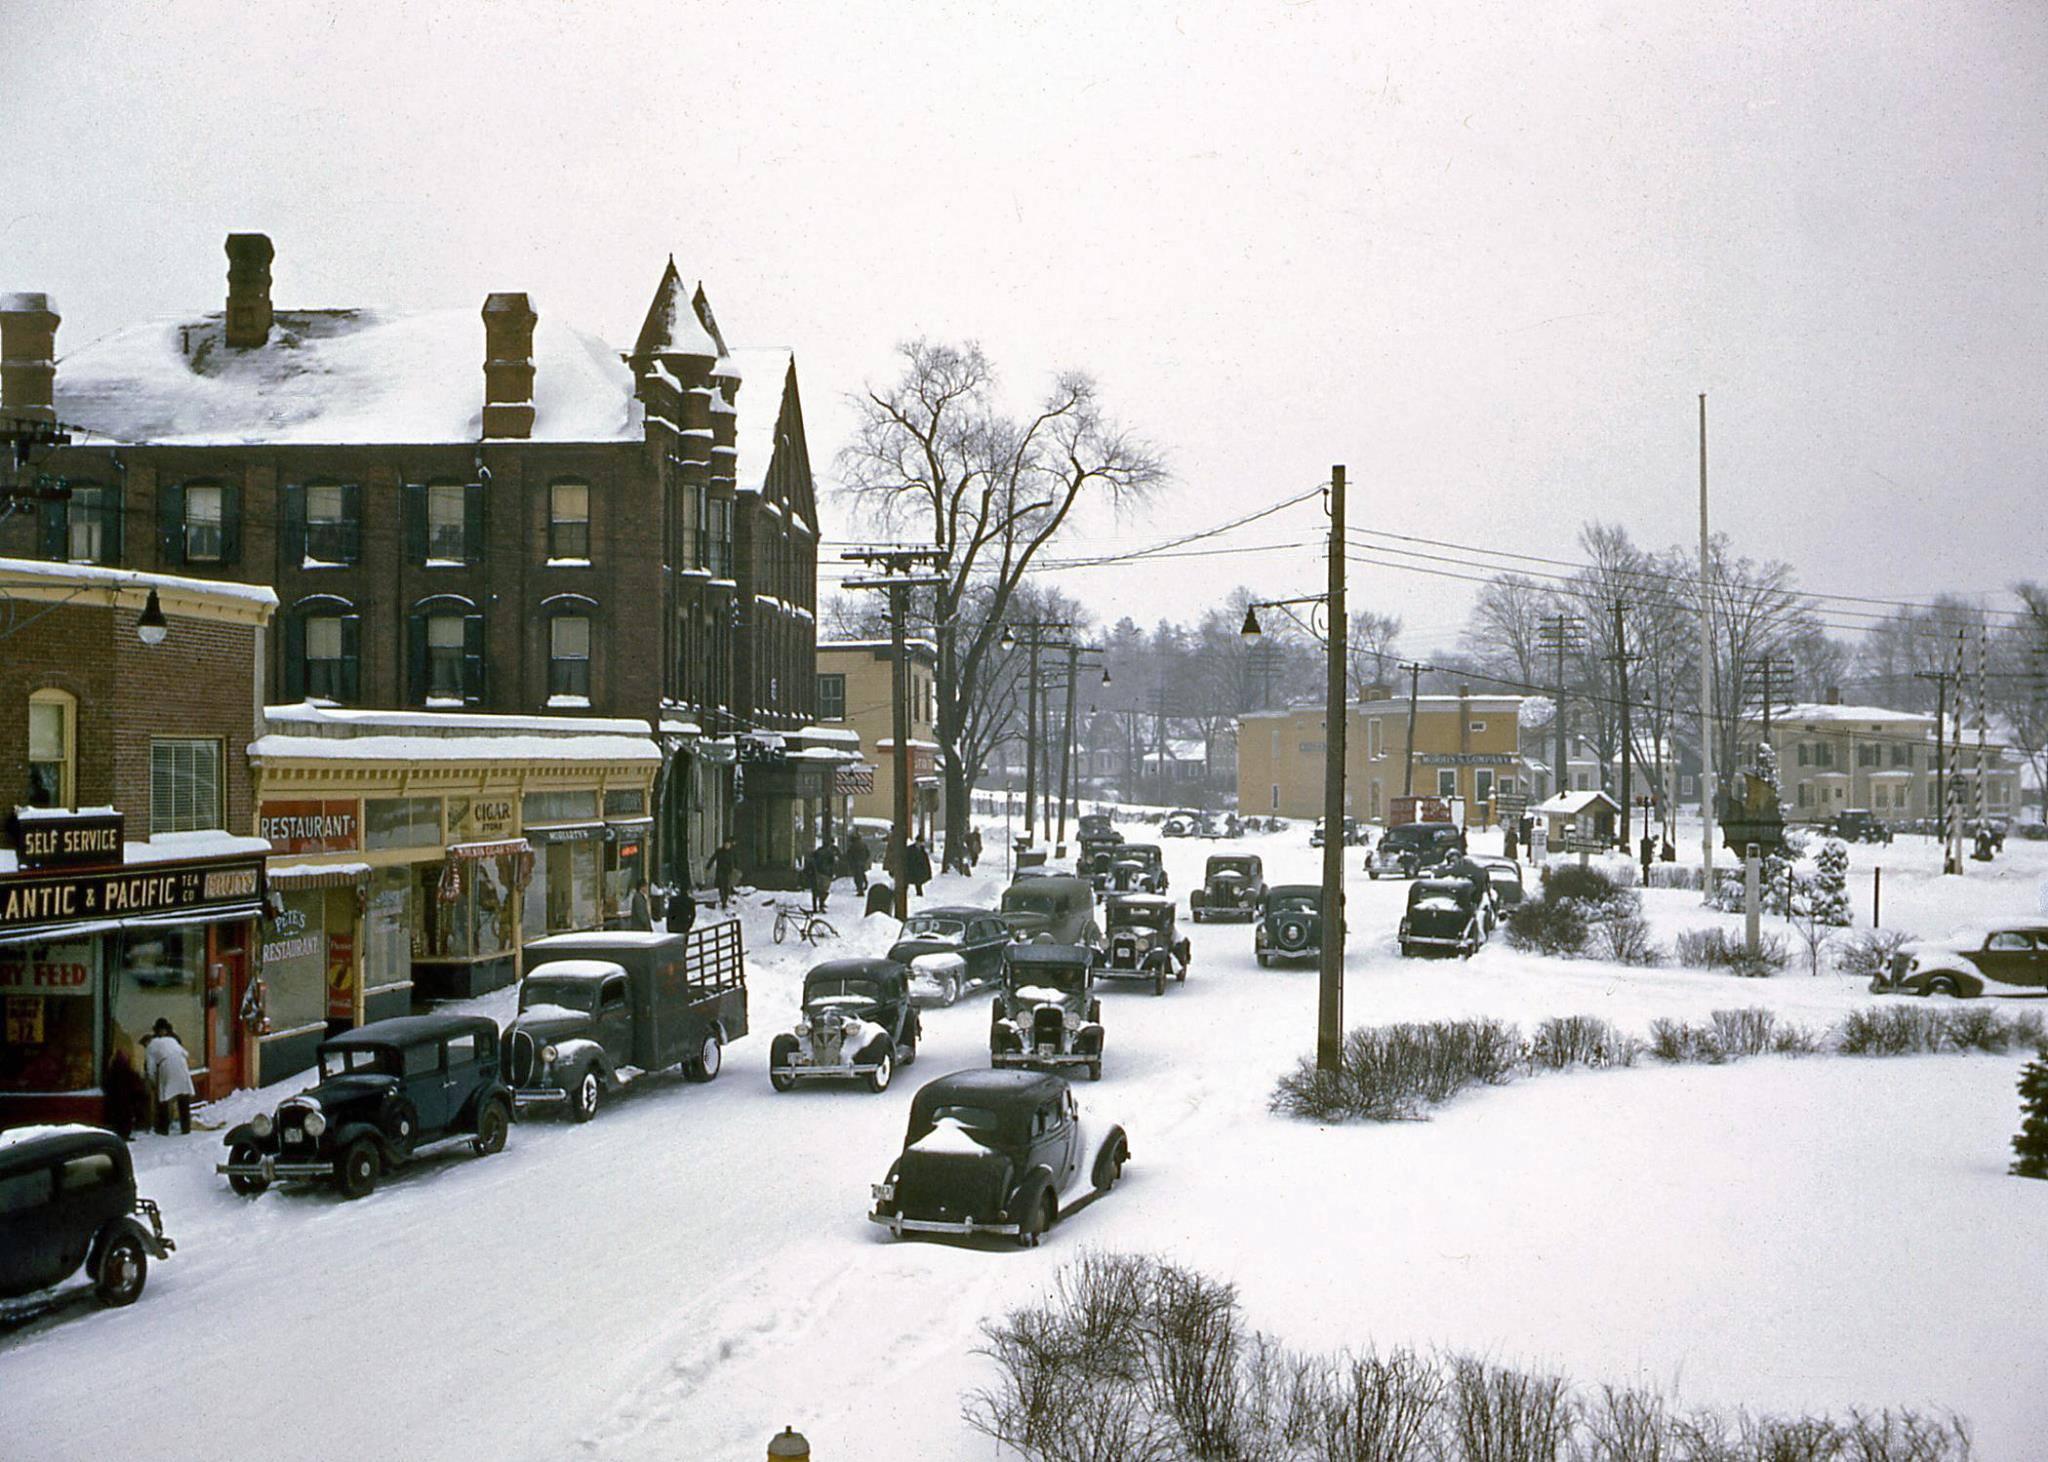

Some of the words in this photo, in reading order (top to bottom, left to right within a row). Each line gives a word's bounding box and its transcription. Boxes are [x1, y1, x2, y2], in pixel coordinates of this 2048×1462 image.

[474, 802, 511, 821] CIGAR
[261, 814, 352, 840] RESTAURANT
[482, 822, 503, 831] STORE
[25, 829, 59, 855] SELF
[63, 828, 117, 852] SERVICE
[181, 874, 199, 887] TEA
[0, 885, 76, 920] ANTIC
[85, 887, 96, 908] &
[104, 877, 176, 911] PACIFIC
[33, 961, 87, 987] FEED
